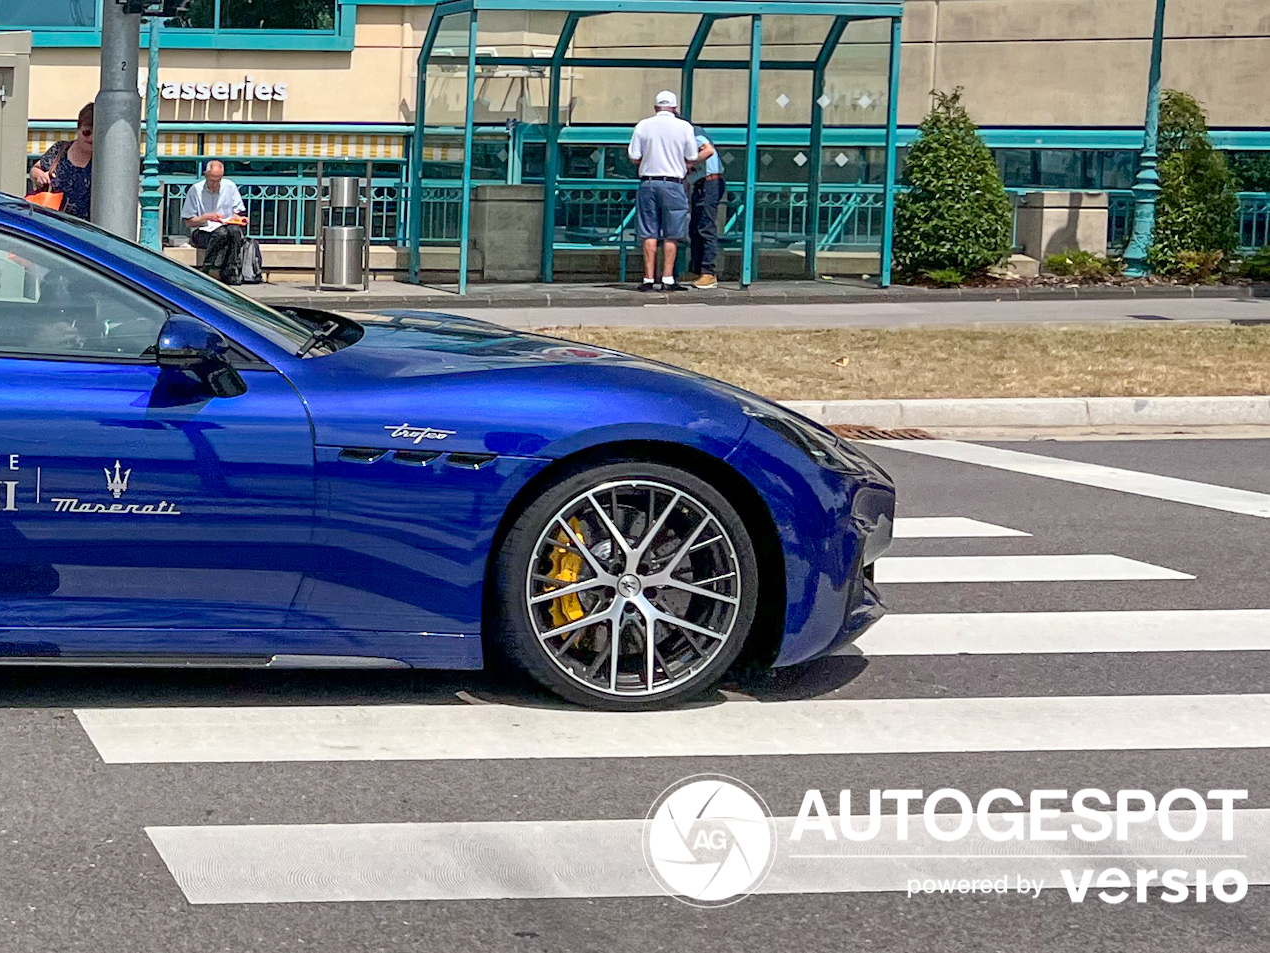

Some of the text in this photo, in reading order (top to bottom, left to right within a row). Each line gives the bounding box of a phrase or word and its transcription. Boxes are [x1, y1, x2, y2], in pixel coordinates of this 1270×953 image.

[121, 60, 127, 72] 2
[383, 422, 457, 445] trofeo
[50, 497, 182, 516] Maserati
